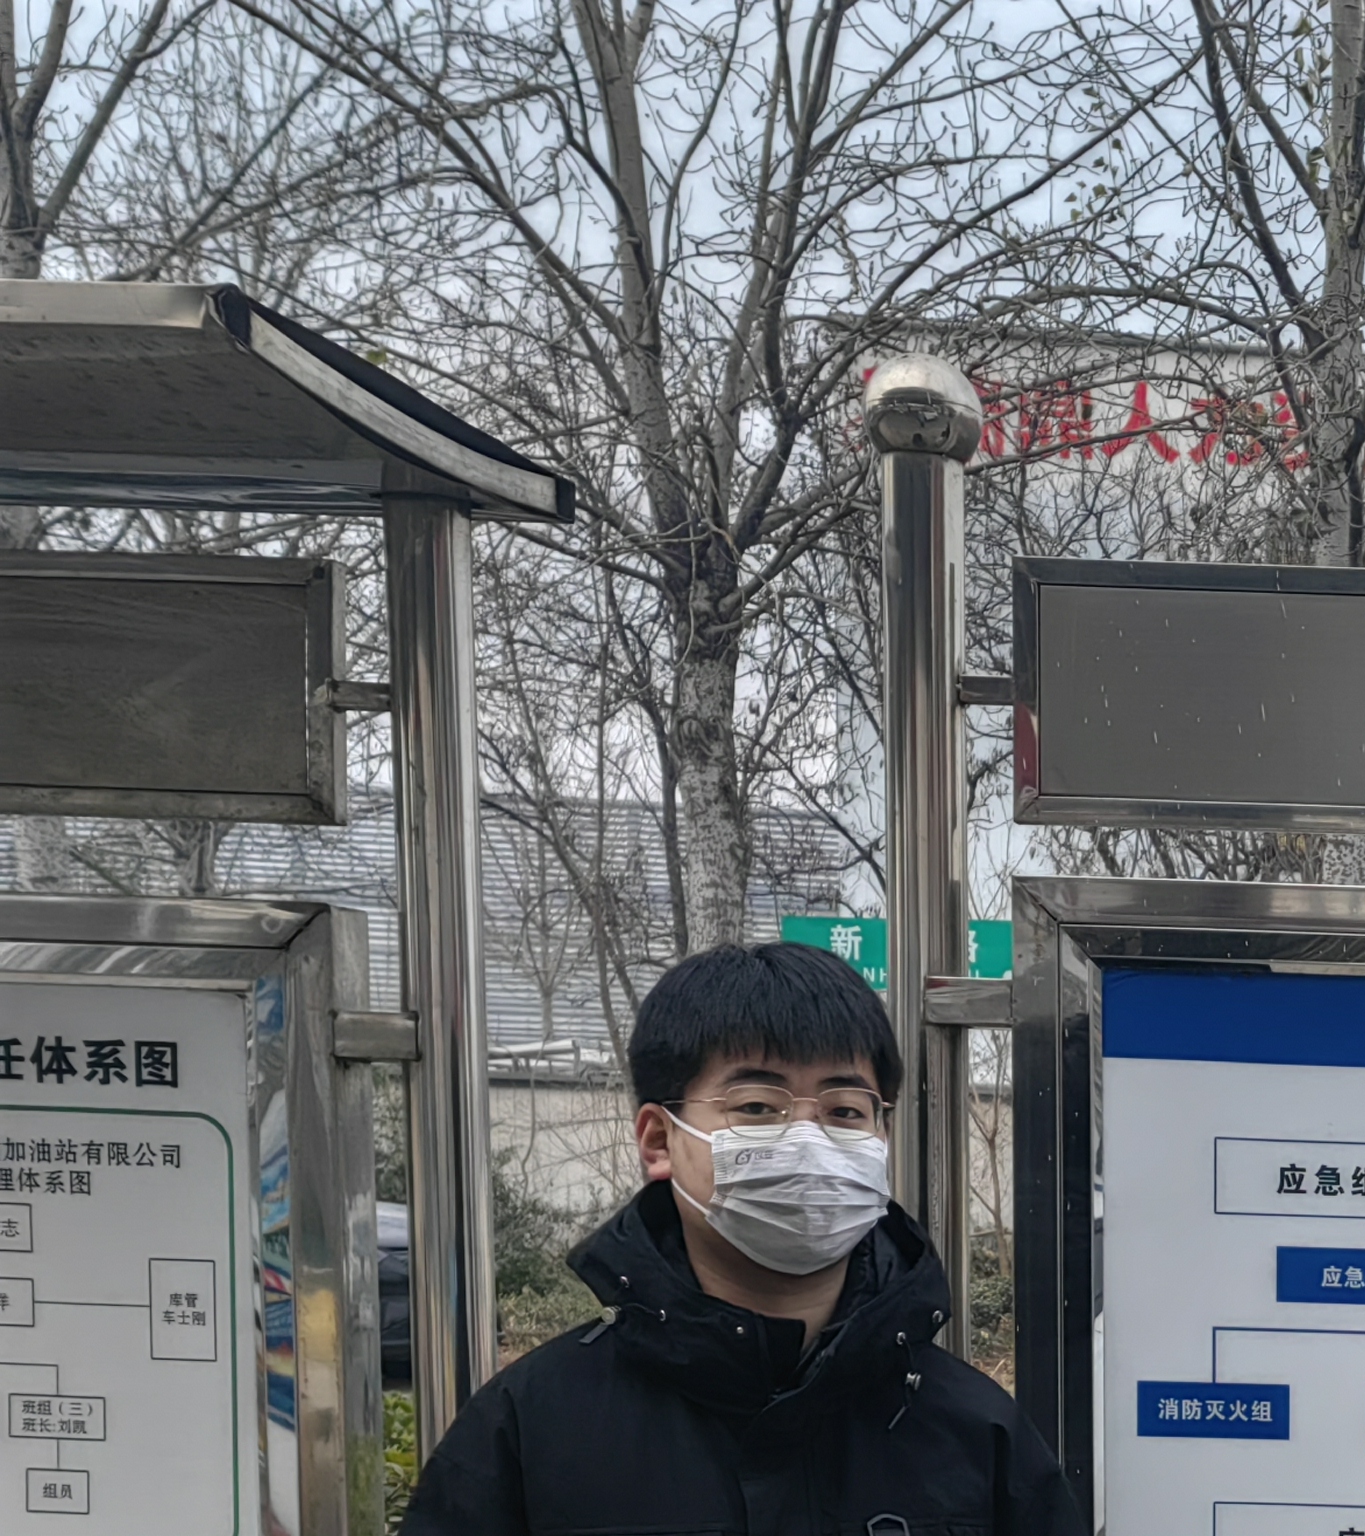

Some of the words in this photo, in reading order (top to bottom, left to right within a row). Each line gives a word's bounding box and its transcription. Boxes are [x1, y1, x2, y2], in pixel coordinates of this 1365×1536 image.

[1, 1137, 182, 1169] 加油站有限公司
[1157, 1398, 1274, 1425] 消防灭火组
